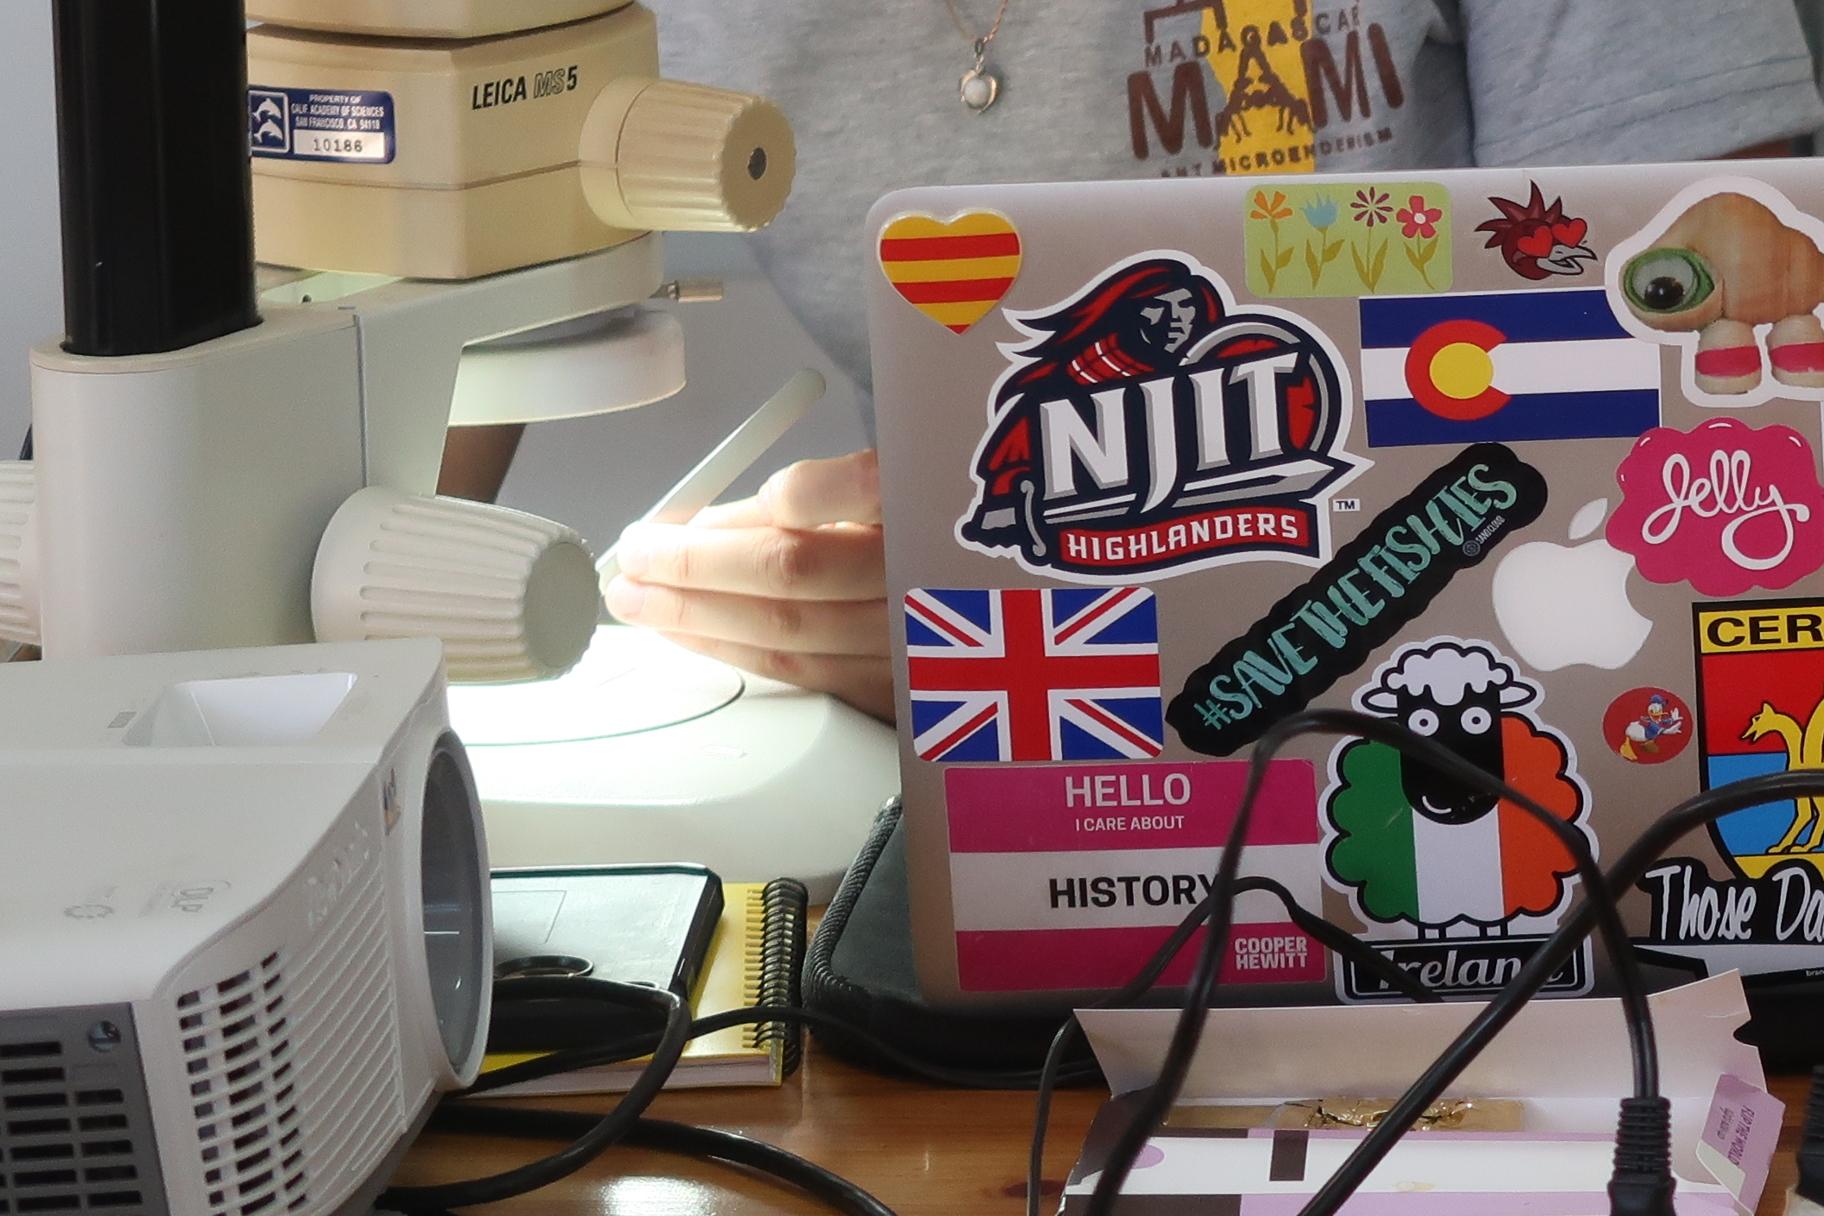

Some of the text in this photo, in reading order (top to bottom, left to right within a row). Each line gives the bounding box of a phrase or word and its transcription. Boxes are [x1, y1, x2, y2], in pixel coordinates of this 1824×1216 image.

[309, 94, 362, 104] PROPERTY OF
[472, 75, 527, 110] LEICA
[310, 104, 340, 116] ACADEMY
[351, 106, 385, 117] SCIENCES
[313, 138, 363, 153] 10186
[1039, 349, 1299, 513] NJIT
[1336, 500, 1356, 510] TM
[1640, 449, 1811, 571] Jelly
[1066, 512, 1299, 565] HIGHLANDERS
[1064, 772, 1192, 808] HELLO
[1075, 812, 1185, 832] I CARE ABOUT
[1646, 865, 1756, 942] Those
[1234, 936, 1308, 954] COOPER
[1235, 952, 1308, 970] HEWITT
[1378, 948, 1564, 990] relan
